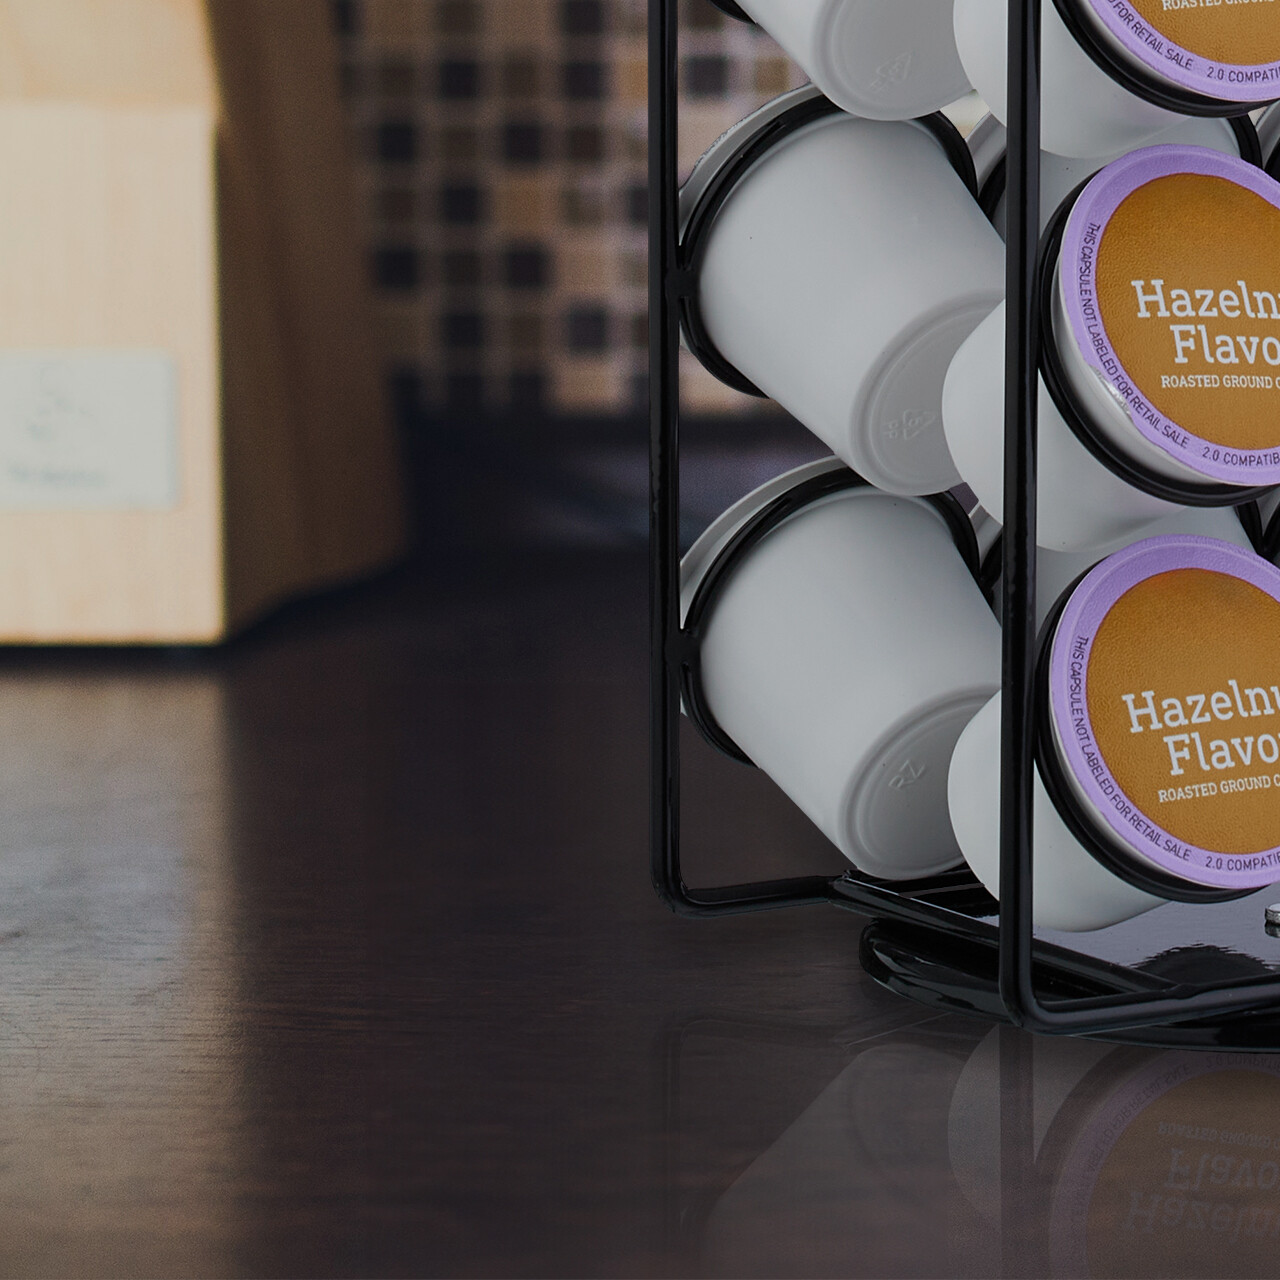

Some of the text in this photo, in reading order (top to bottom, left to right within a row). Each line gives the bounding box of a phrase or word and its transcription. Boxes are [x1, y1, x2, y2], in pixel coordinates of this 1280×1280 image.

[1207, 66, 1225, 81] 2.0
[1160, 375, 1220, 388] ROASTED
[1223, 375, 1273, 388] GROUND
[1202, 446, 1220, 462] 2.0
[1158, 782, 1218, 804] ROASTED
[1220, 774, 1271, 794] GROUND
[1206, 856, 1223, 871] 2.0
